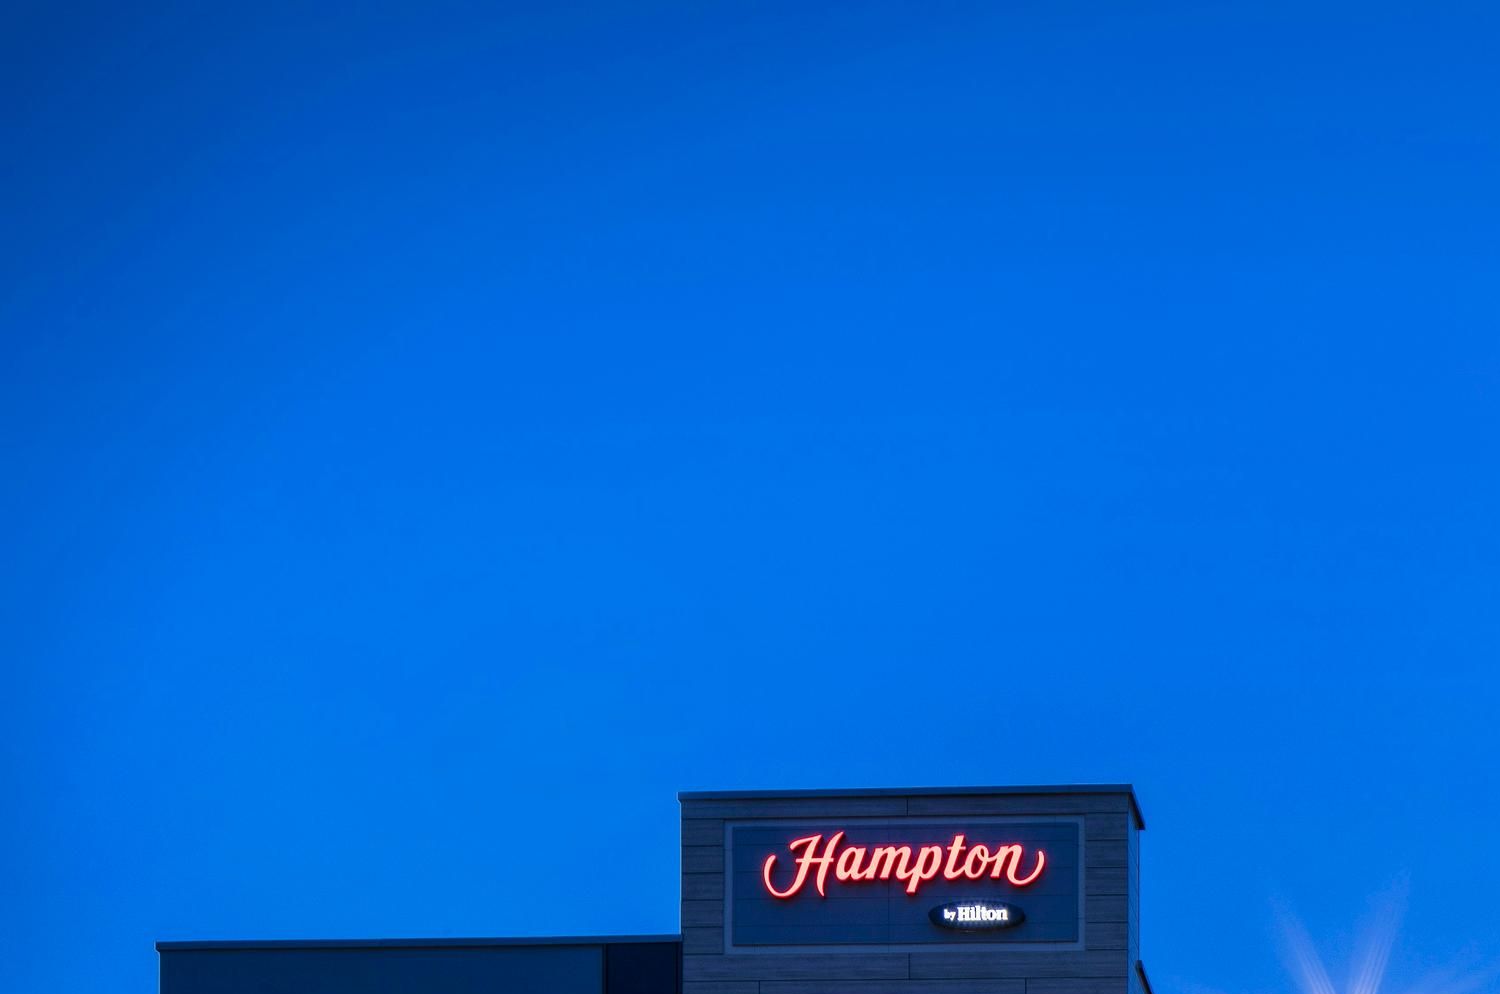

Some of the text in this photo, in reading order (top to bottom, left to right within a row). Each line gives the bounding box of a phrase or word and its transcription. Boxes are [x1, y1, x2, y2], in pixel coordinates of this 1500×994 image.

[763, 831, 1046, 899] Hampton
[943, 905, 1009, 922] by Hilton
